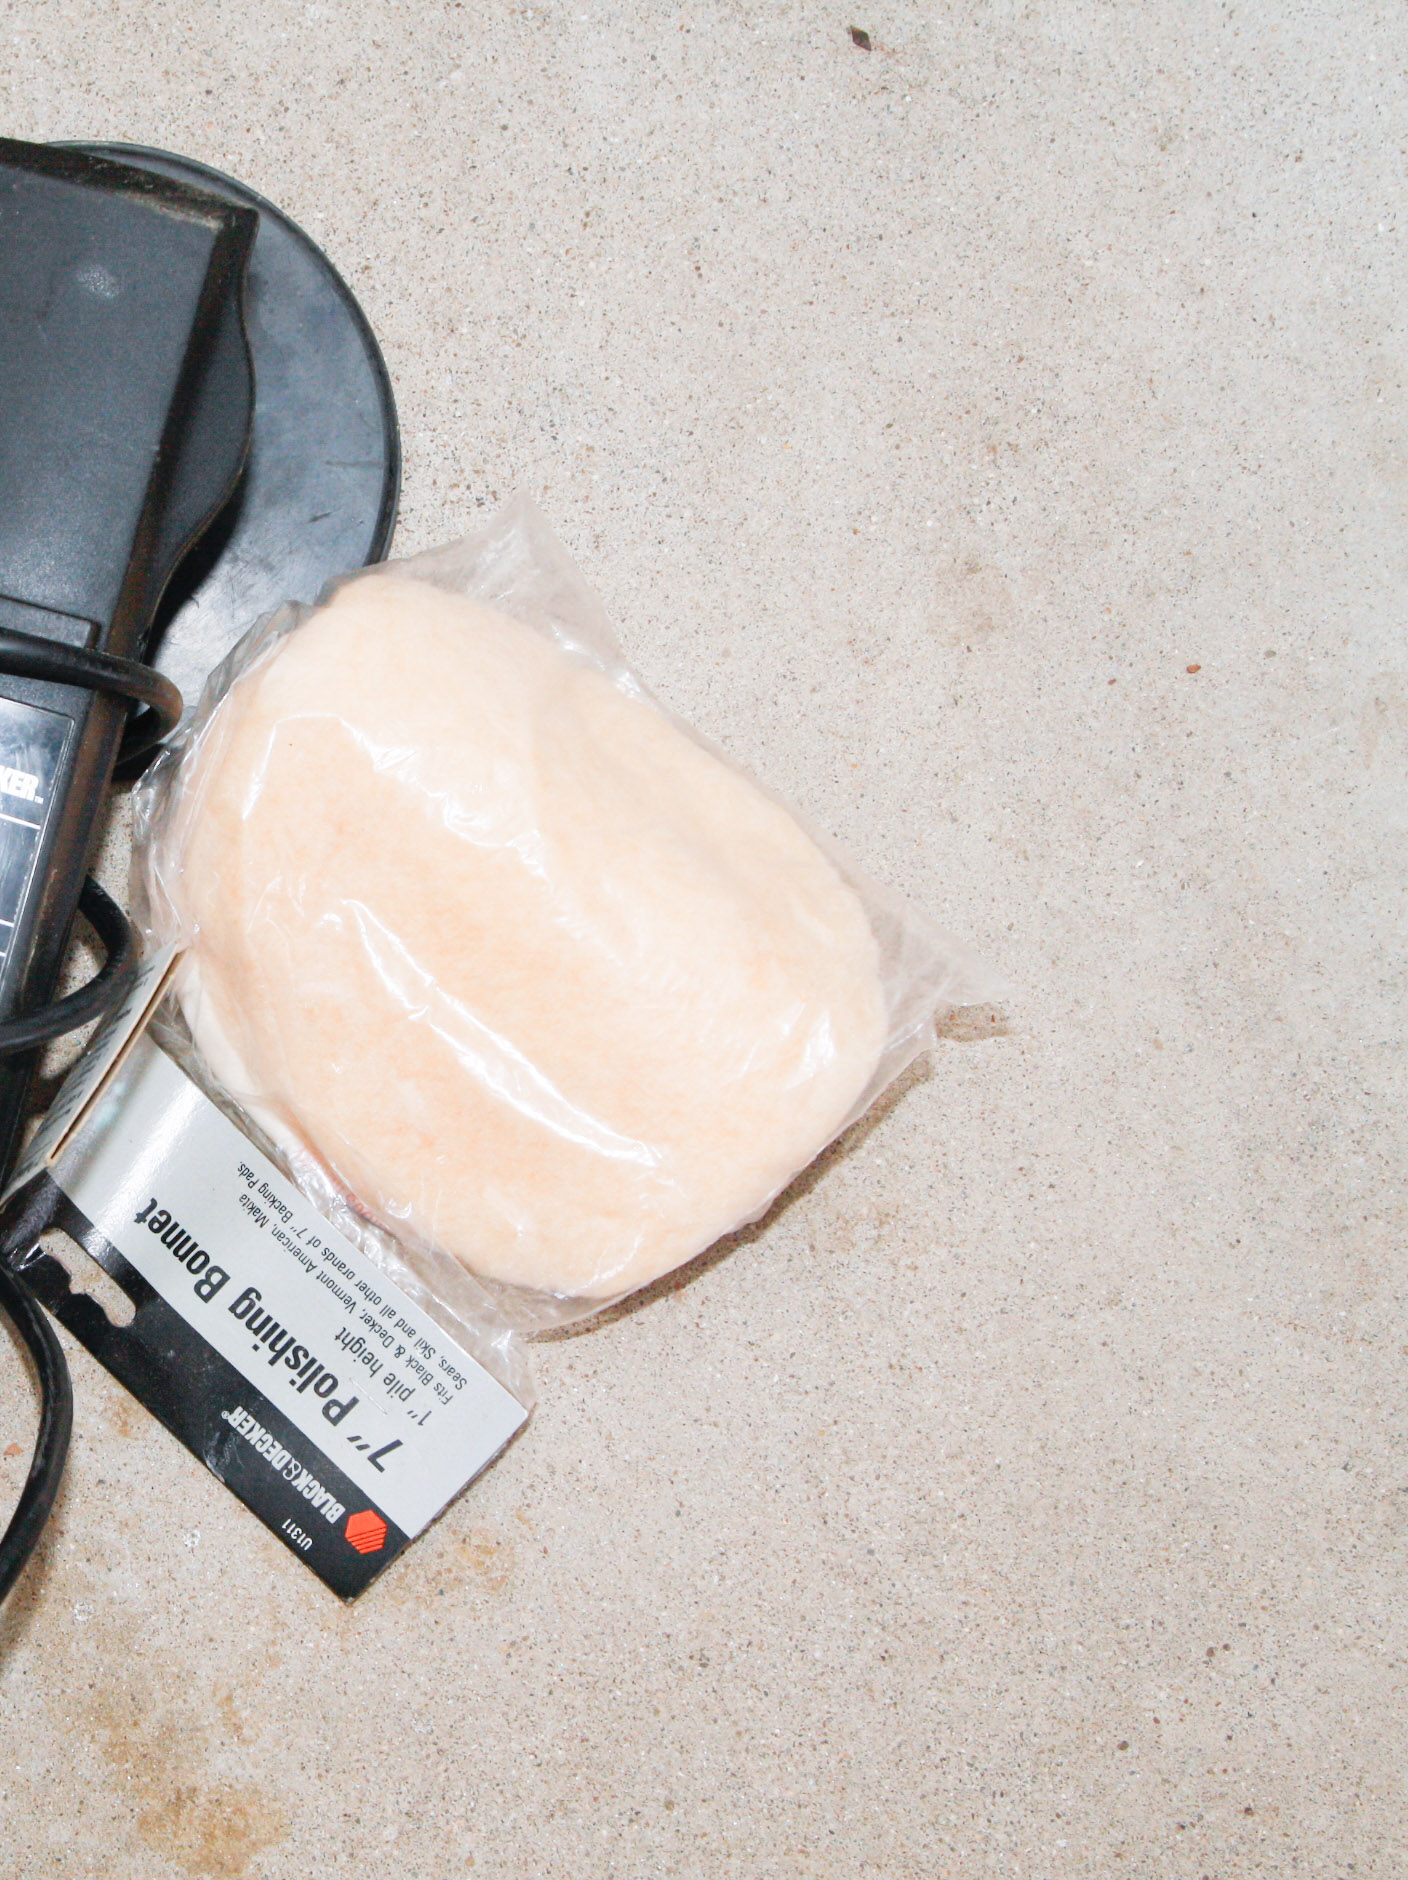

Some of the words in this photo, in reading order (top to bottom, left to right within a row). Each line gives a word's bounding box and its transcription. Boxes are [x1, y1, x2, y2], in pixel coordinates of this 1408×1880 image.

[237, 1161, 260, 1189] Pads.
[238, 1194, 270, 1229] Makita
[257, 1182, 294, 1224] Backing
[134, 1197, 231, 1304] Bonnet
[271, 1223, 318, 1274] American,
[305, 1235, 322, 1248] of
[315, 1270, 357, 1314] Vermont
[354, 1280, 382, 1306] other
[379, 1304, 397, 1319] all
[393, 1318, 417, 1339] and
[227, 1286, 360, 1427] Polishing
[334, 1327, 384, 1378] height
[394, 1344, 406, 1359] &
[413, 1337, 436, 1360] Skil
[405, 1355, 434, 1386] Black
[438, 1356, 468, 1391] Sears,
[383, 1372, 416, 1402] pile
[433, 1382, 454, 1406] Fits
[346, 1435, 404, 1473] 7"
[281, 1518, 313, 1551] U1311
